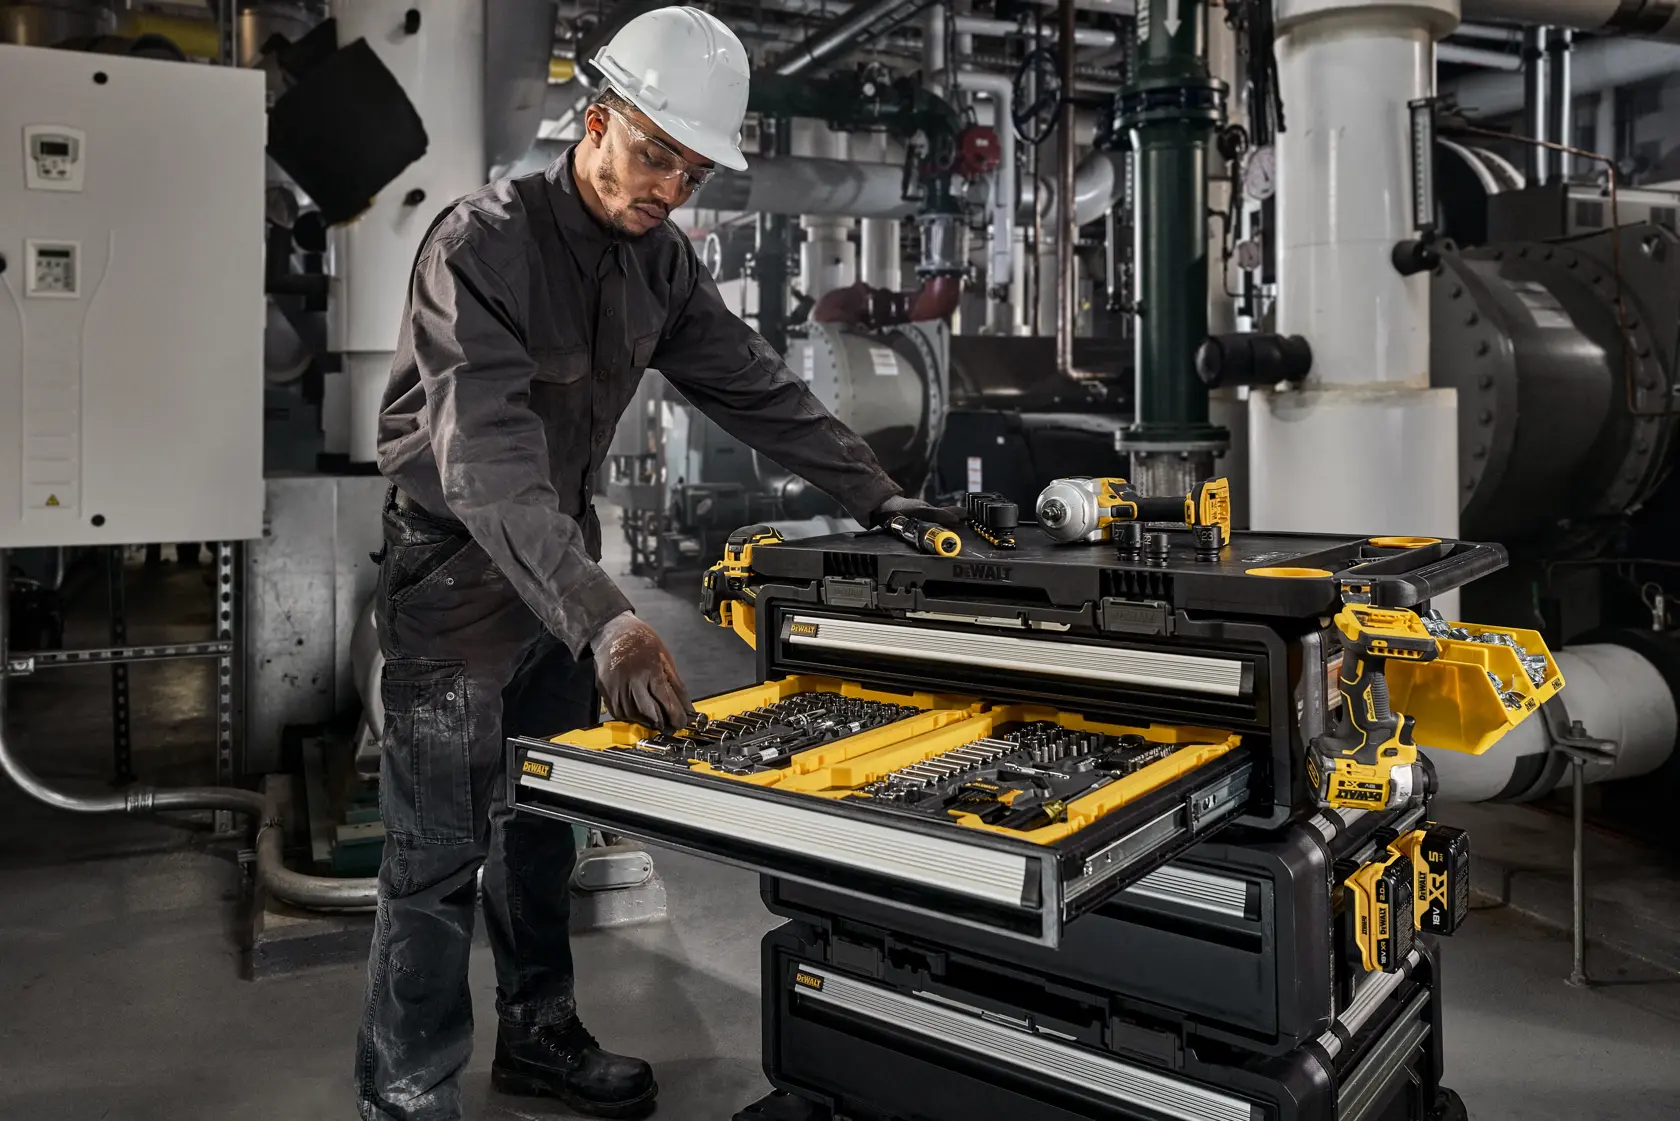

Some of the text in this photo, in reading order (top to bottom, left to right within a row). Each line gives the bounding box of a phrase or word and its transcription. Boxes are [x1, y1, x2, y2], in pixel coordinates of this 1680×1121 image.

[1201, 531, 1214, 541] 23
[1428, 850, 1439, 863] 5
[1432, 907, 1441, 926] 18V
